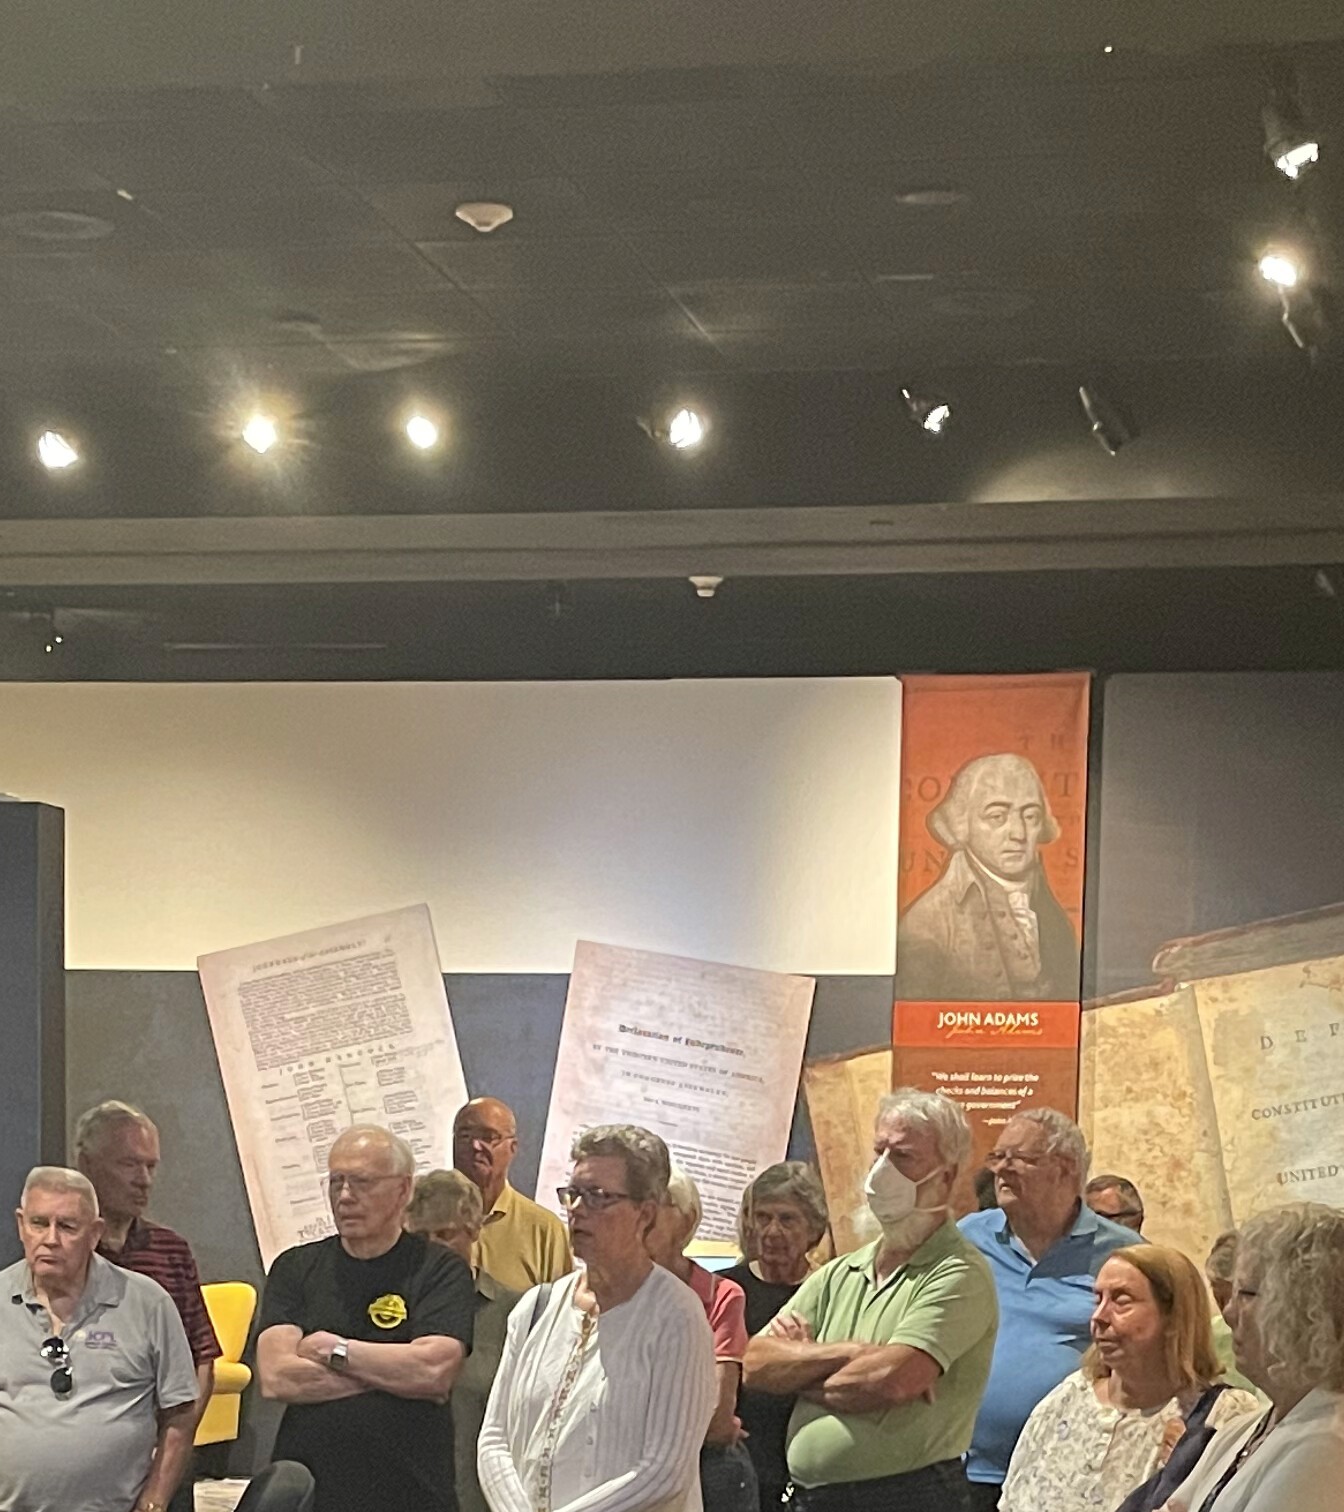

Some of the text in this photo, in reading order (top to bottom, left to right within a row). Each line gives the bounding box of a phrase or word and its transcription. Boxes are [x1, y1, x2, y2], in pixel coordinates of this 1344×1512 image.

[937, 1012, 1039, 1029] JOHN ADAMS
[1276, 1164, 1339, 1186] UNITED
